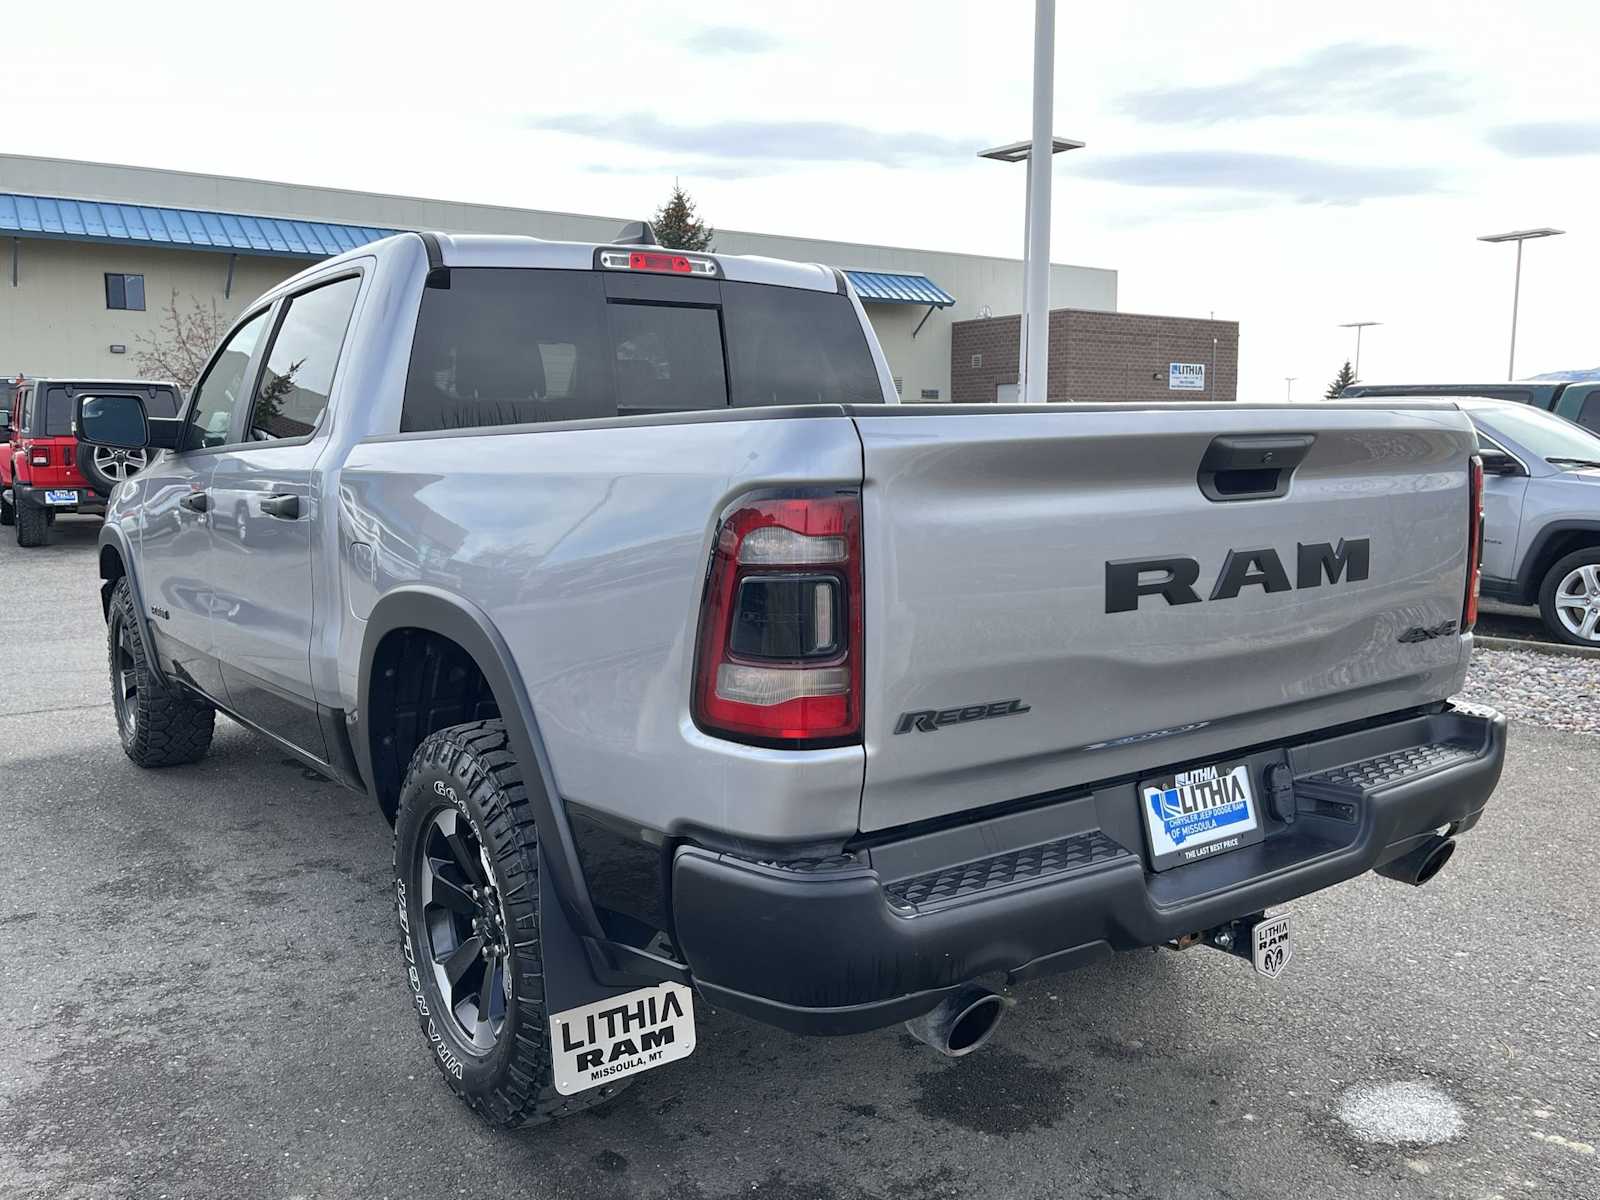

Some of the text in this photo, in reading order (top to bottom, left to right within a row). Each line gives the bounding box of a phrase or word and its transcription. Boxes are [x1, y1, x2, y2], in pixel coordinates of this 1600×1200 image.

[1178, 365, 1203, 375] LITHIA
[1105, 536, 1370, 614] RAM
[893, 697, 1032, 735] REBEL
[1185, 766, 1218, 784] LITHIA
[1179, 775, 1245, 813] LITHIA
[1169, 802, 1246, 829] CHRYSLER JEEP DODGE RAM
[1170, 819, 1217, 839] OF MISSOULA
[1185, 838, 1239, 860] THE LAST BEST PRICE
[1259, 922, 1287, 941] LITHIA
[1259, 932, 1288, 950] RAM
[396, 878, 464, 1081] WRANGLER
[561, 990, 684, 1053] LITHIA
[576, 1025, 676, 1073] RAM
[591, 1050, 664, 1081] MISSOULA, MT
